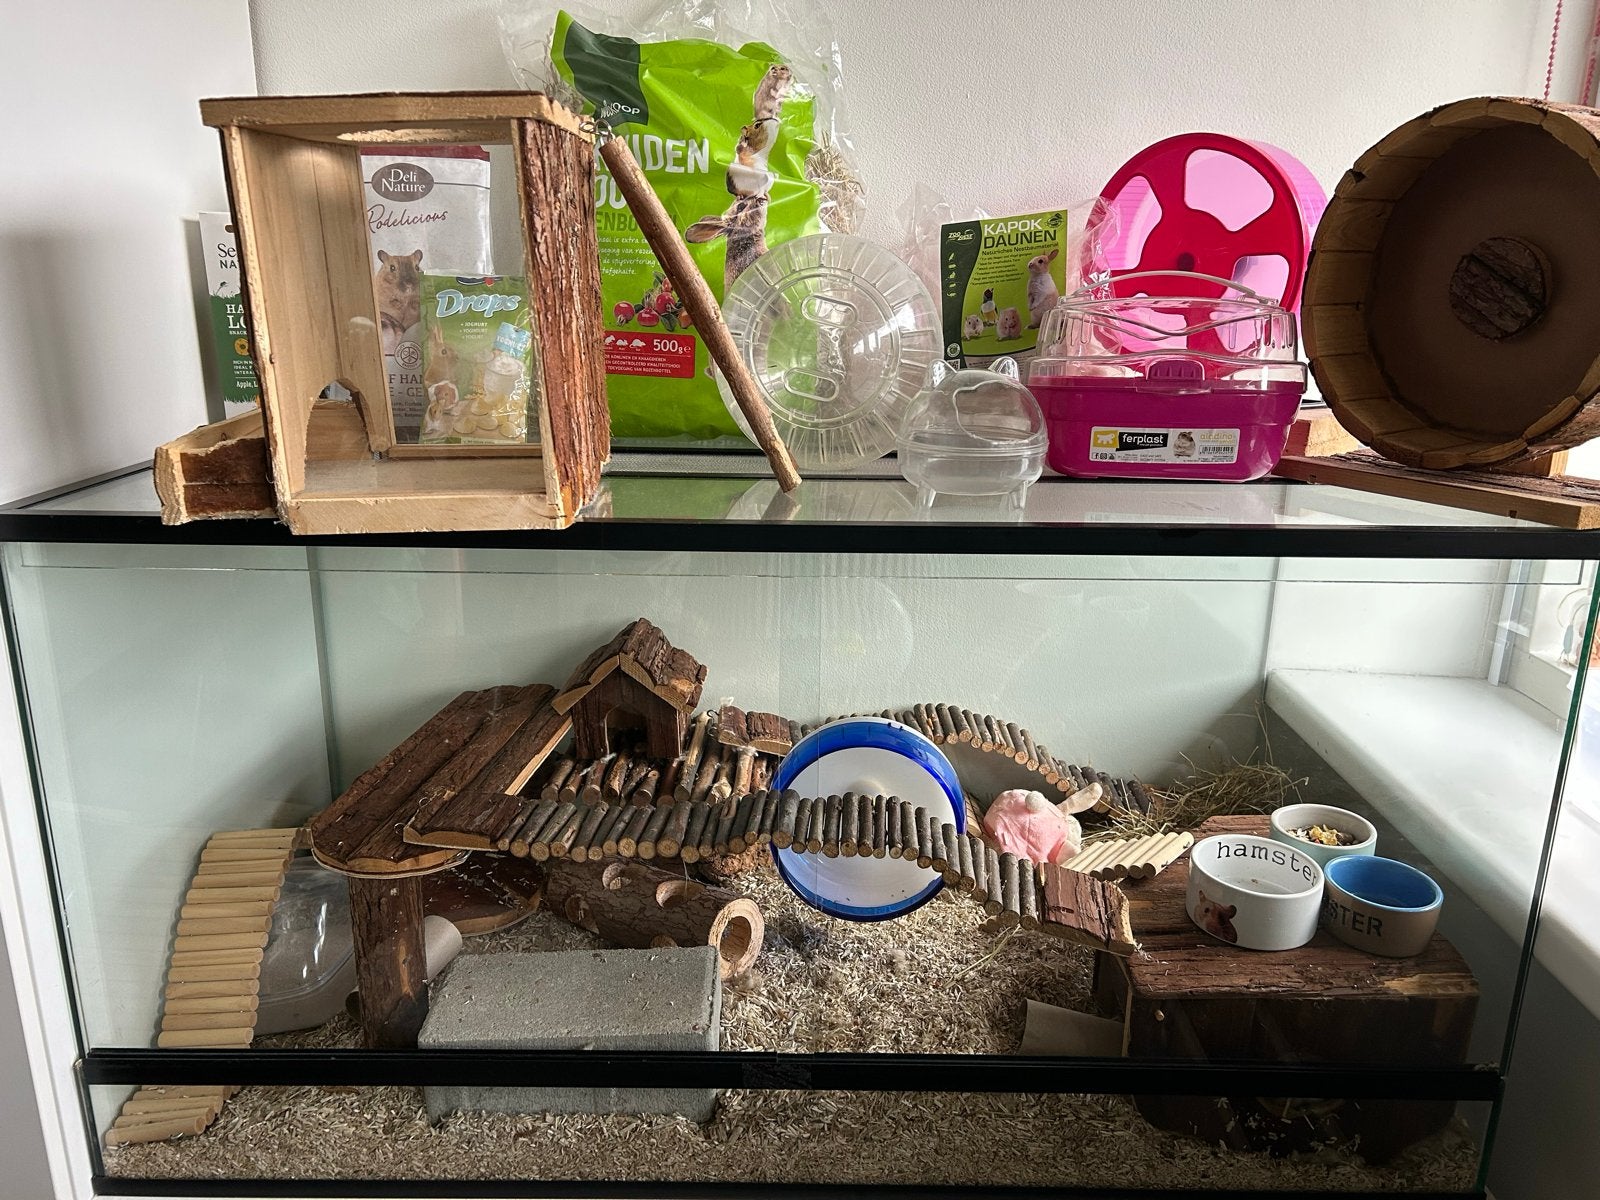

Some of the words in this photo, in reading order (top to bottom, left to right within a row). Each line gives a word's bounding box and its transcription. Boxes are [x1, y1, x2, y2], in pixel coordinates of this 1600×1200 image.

[389, 168, 417, 182] Deli
[381, 178, 426, 193] Nature
[367, 203, 448, 234] Rodelicious
[984, 218, 1042, 237] KAPOK
[984, 229, 1057, 249] DAUNEN
[217, 243, 236, 258] Se
[220, 260, 238, 269] NA
[225, 303, 244, 314] HA
[436, 288, 522, 318] Drops
[1122, 433, 1164, 445] ferplast
